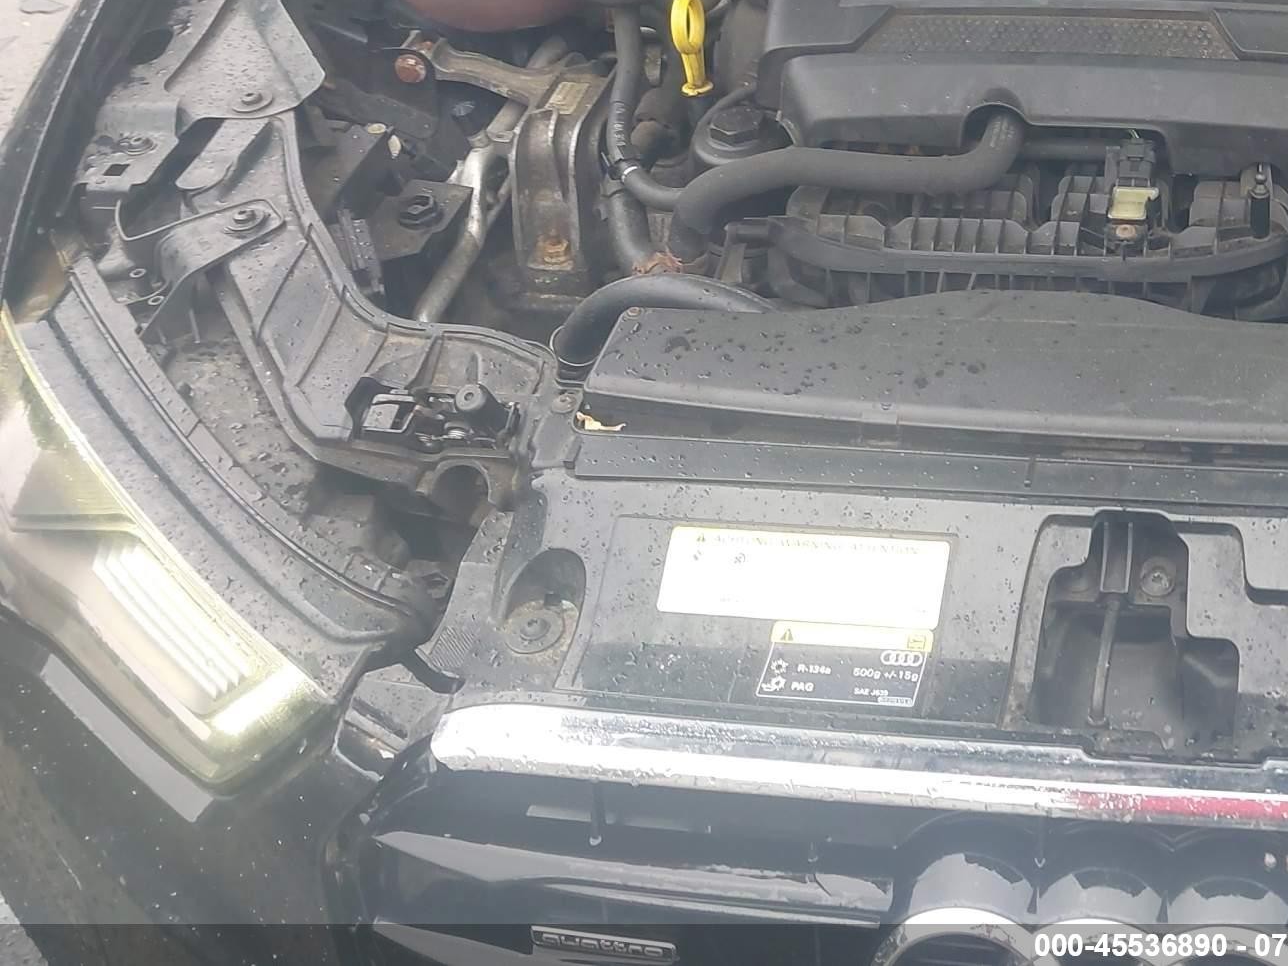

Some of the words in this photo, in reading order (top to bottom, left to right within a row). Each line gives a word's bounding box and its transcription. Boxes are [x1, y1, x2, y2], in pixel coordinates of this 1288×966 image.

[797, 663, 832, 675] R-134a
[853, 667, 881, 679] 500g
[791, 681, 814, 692] PAG
[541, 932, 664, 958] quattro
